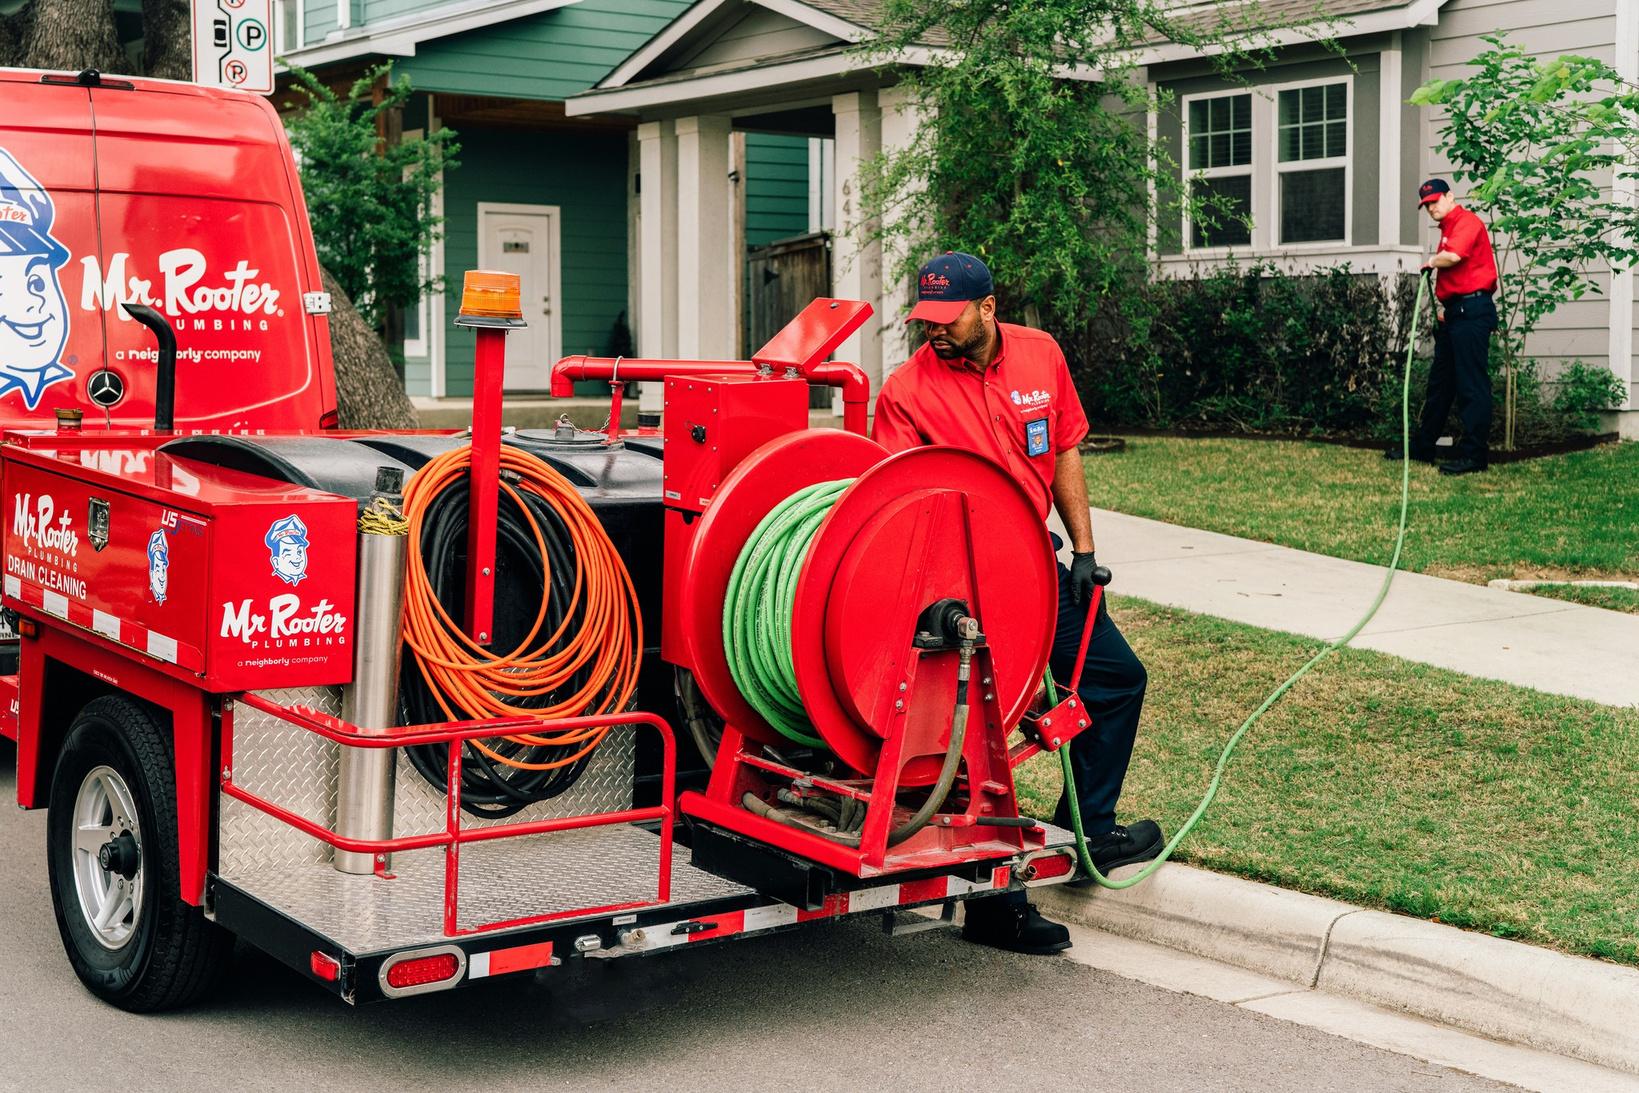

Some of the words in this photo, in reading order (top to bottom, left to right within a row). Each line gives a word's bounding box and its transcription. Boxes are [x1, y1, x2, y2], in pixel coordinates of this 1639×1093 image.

[246, 26, 262, 46] P
[142, 319, 269, 331] UMBING
[115, 350, 125, 360] a
[129, 347, 200, 363] neigorly
[204, 350, 261, 363] company
[38, 494, 79, 557] Rooter
[161, 509, 179, 528] US
[28, 546, 78, 573] PLUMBING
[8, 554, 36, 581] DRAIN
[38, 566, 87, 600] CLEANING
[269, 593, 347, 638] Rooter
[252, 637, 346, 649] PLUMBING
[245, 656, 290, 668] neighborly
[291, 655, 328, 664] company
